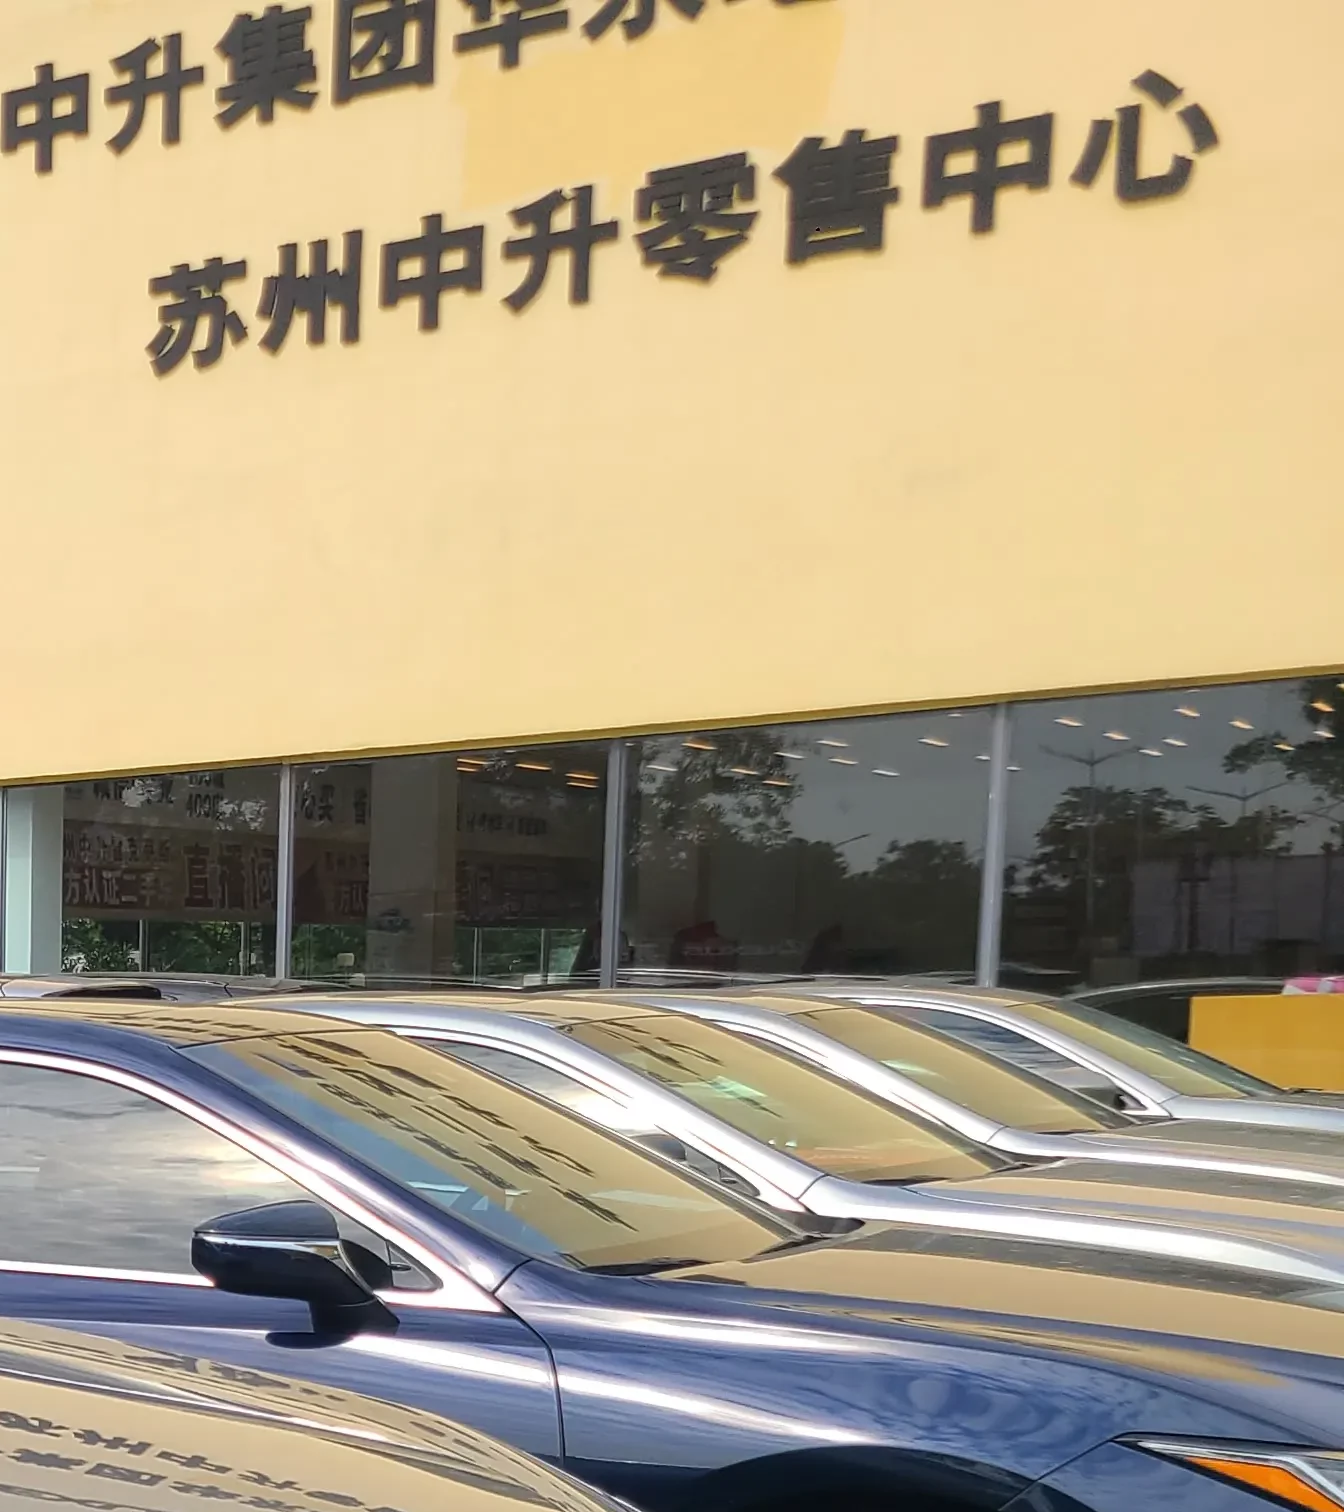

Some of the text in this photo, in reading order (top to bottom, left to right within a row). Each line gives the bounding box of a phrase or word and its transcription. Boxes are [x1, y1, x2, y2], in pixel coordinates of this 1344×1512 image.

[0, 0, 837, 174] 中升集团华
[146, 69, 1220, 377] 苏州中升零售中心
